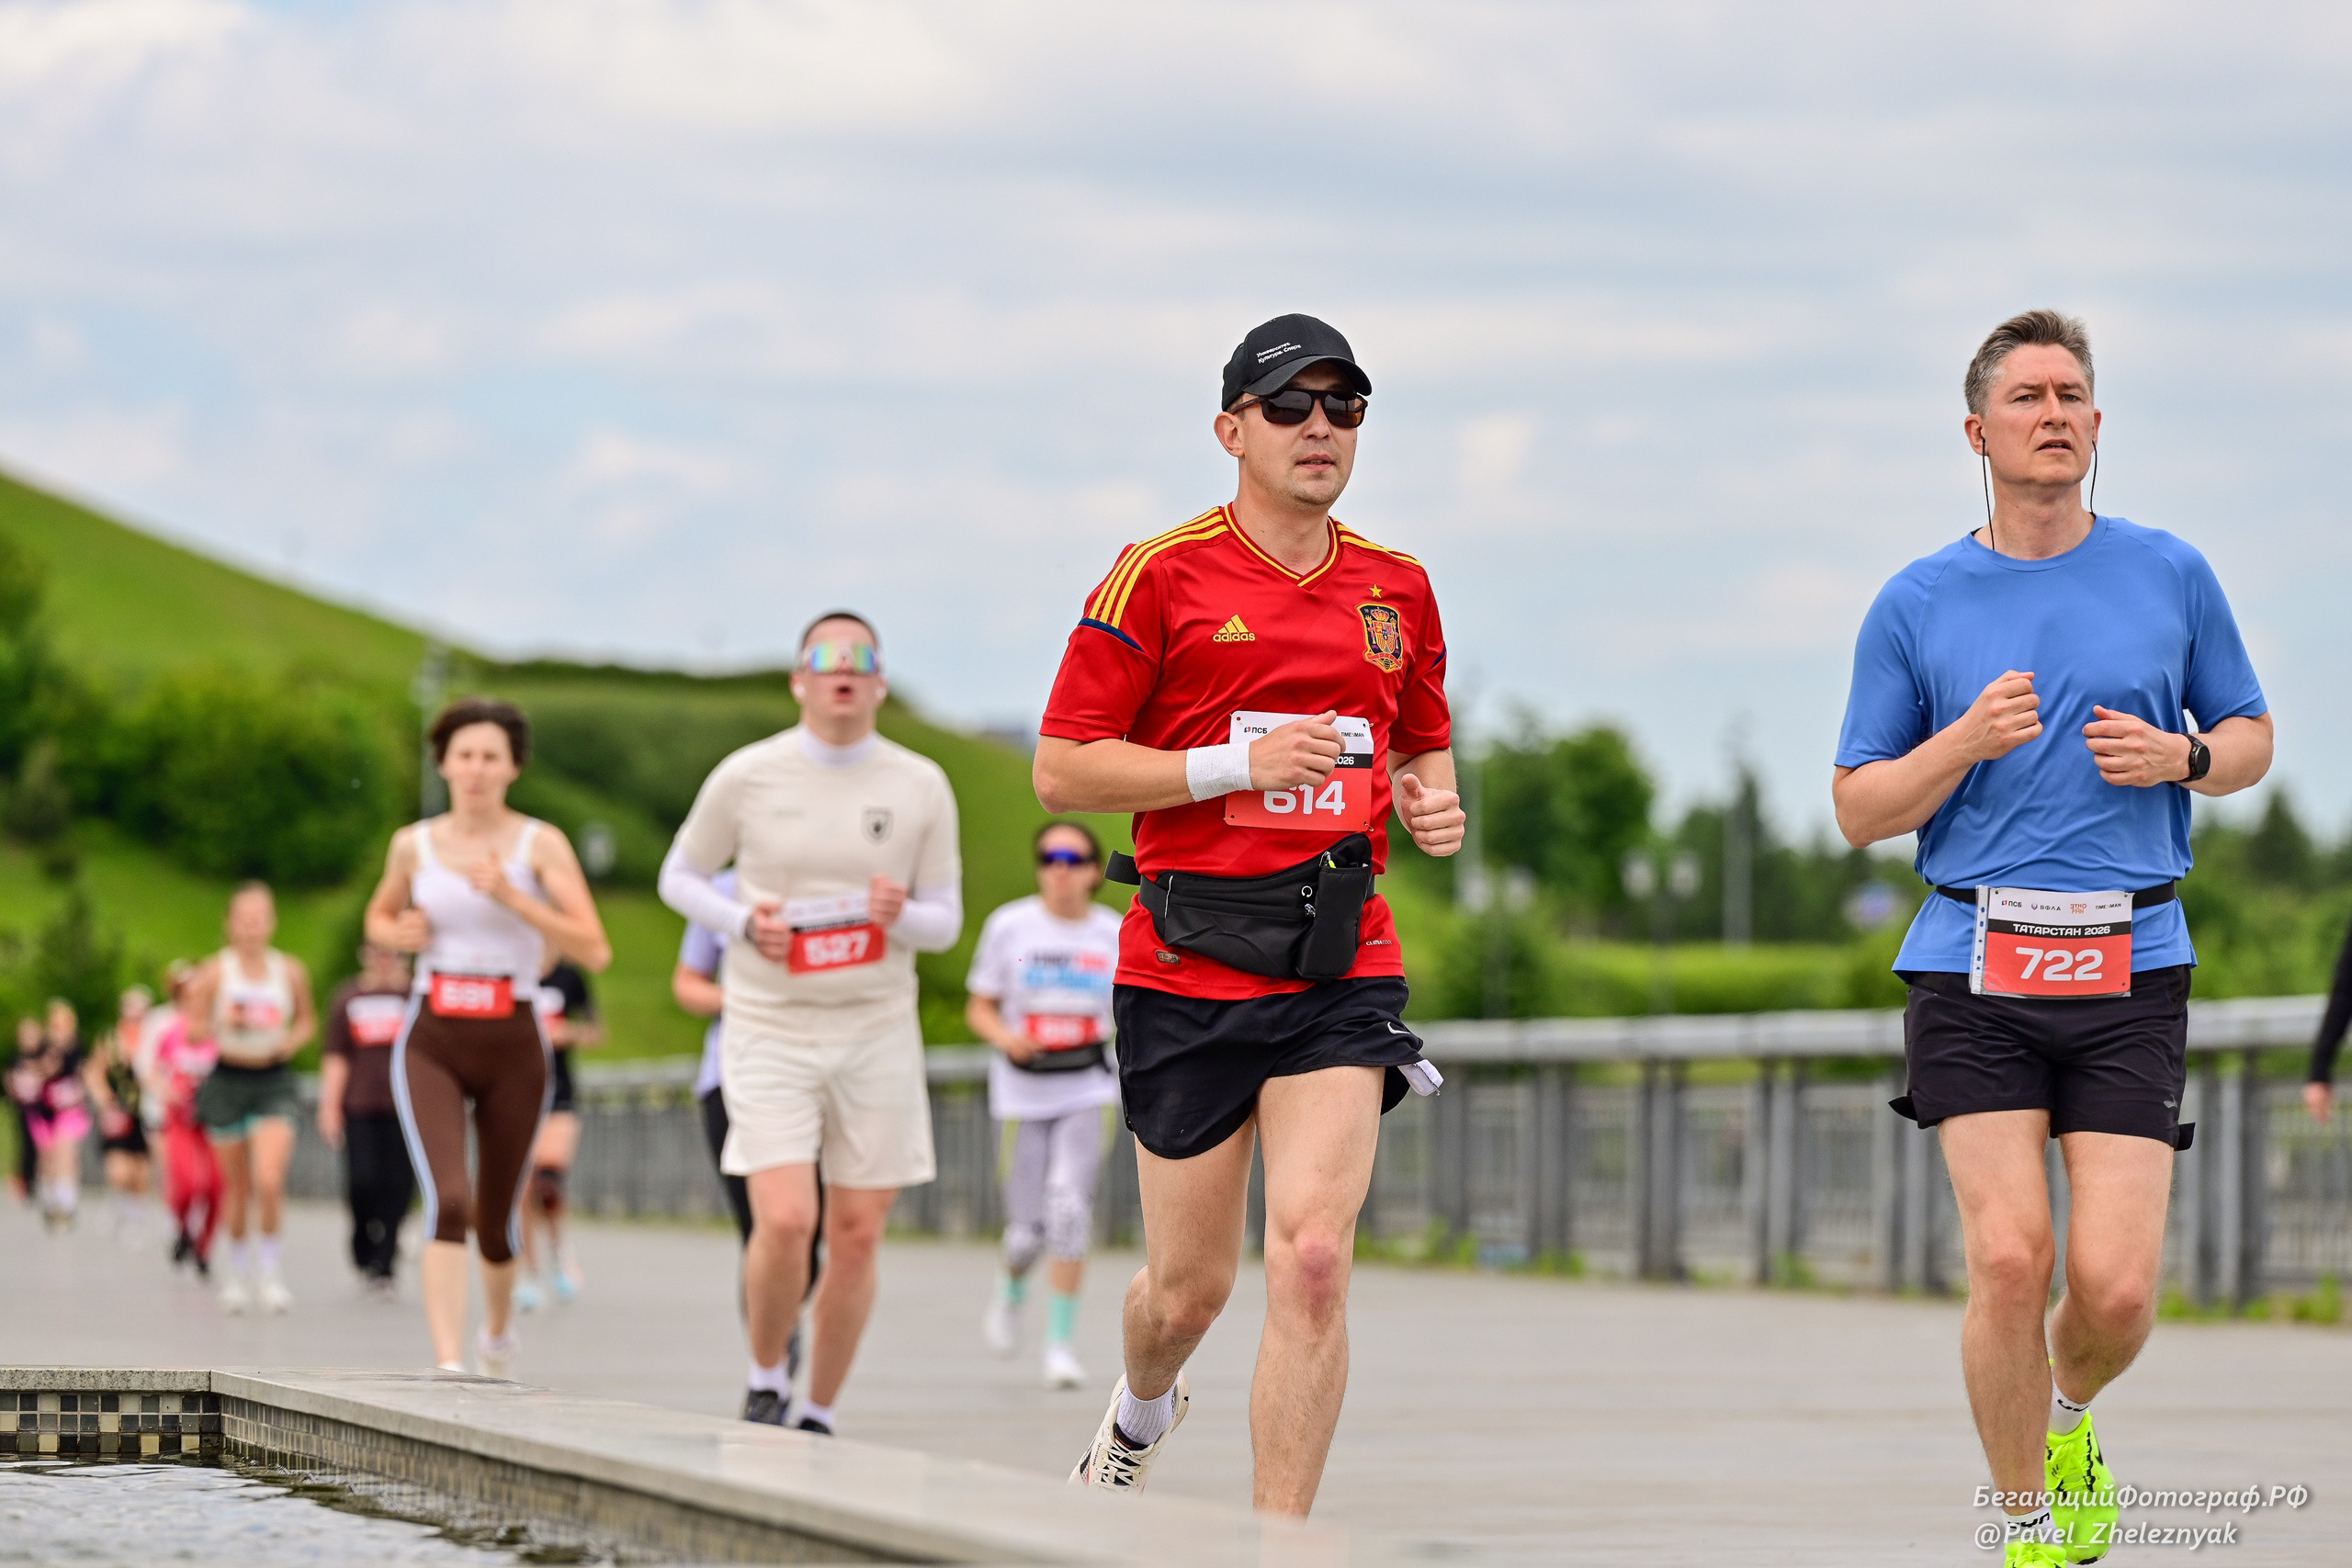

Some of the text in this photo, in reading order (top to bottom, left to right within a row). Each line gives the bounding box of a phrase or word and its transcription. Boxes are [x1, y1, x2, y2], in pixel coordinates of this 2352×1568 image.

[1213, 631, 1256, 642] adidas
[1335, 755, 1355, 765] 026
[1263, 780, 1346, 816] 614
[2012, 923, 2111, 937] ТАТАРСТАН 2026
[803, 929, 872, 967] 527
[2015, 946, 2104, 982] 722
